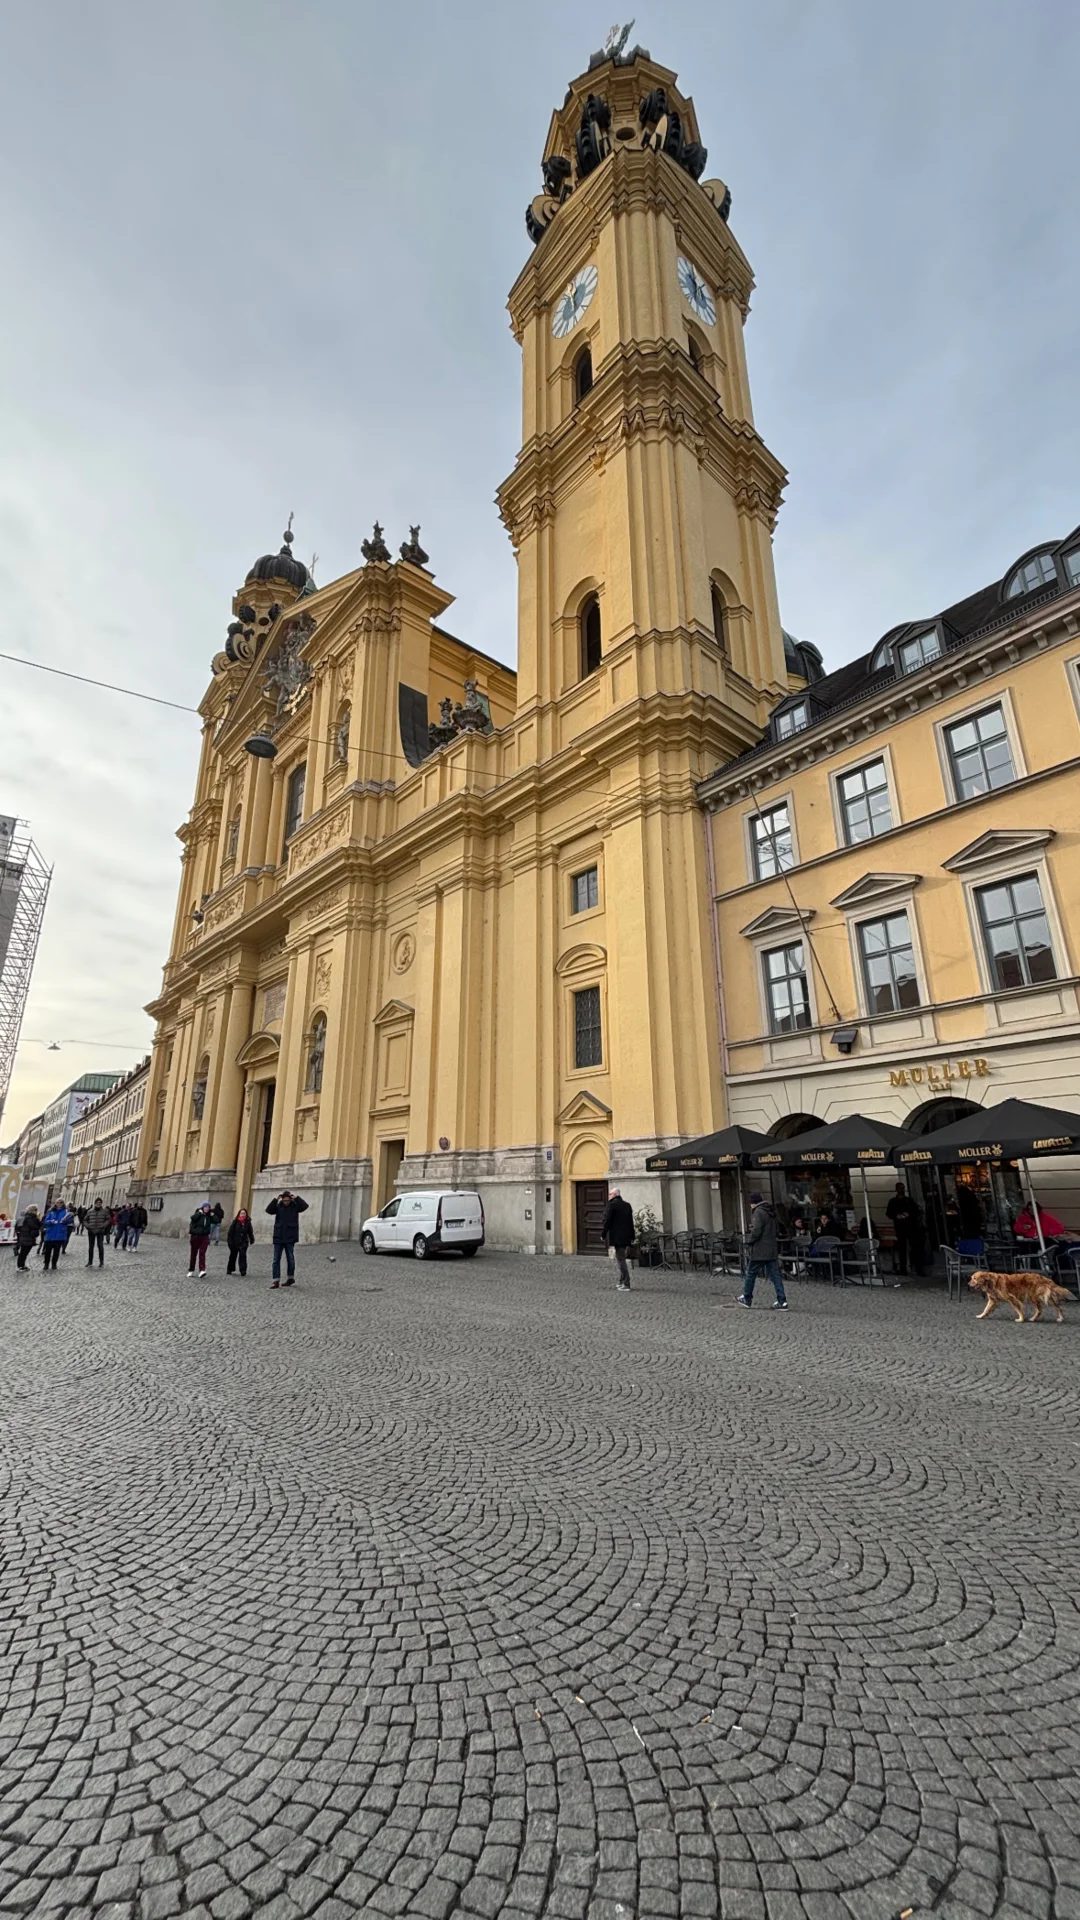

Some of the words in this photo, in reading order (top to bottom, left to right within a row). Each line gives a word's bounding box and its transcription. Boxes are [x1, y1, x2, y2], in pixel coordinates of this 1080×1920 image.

[889, 1058, 992, 1087] MÜLLER
[1033, 1136, 1073, 1149] LAVAZZA
[857, 1148, 885, 1159] LAVAZZA
[900, 1150, 932, 1162] LAVAZZA
